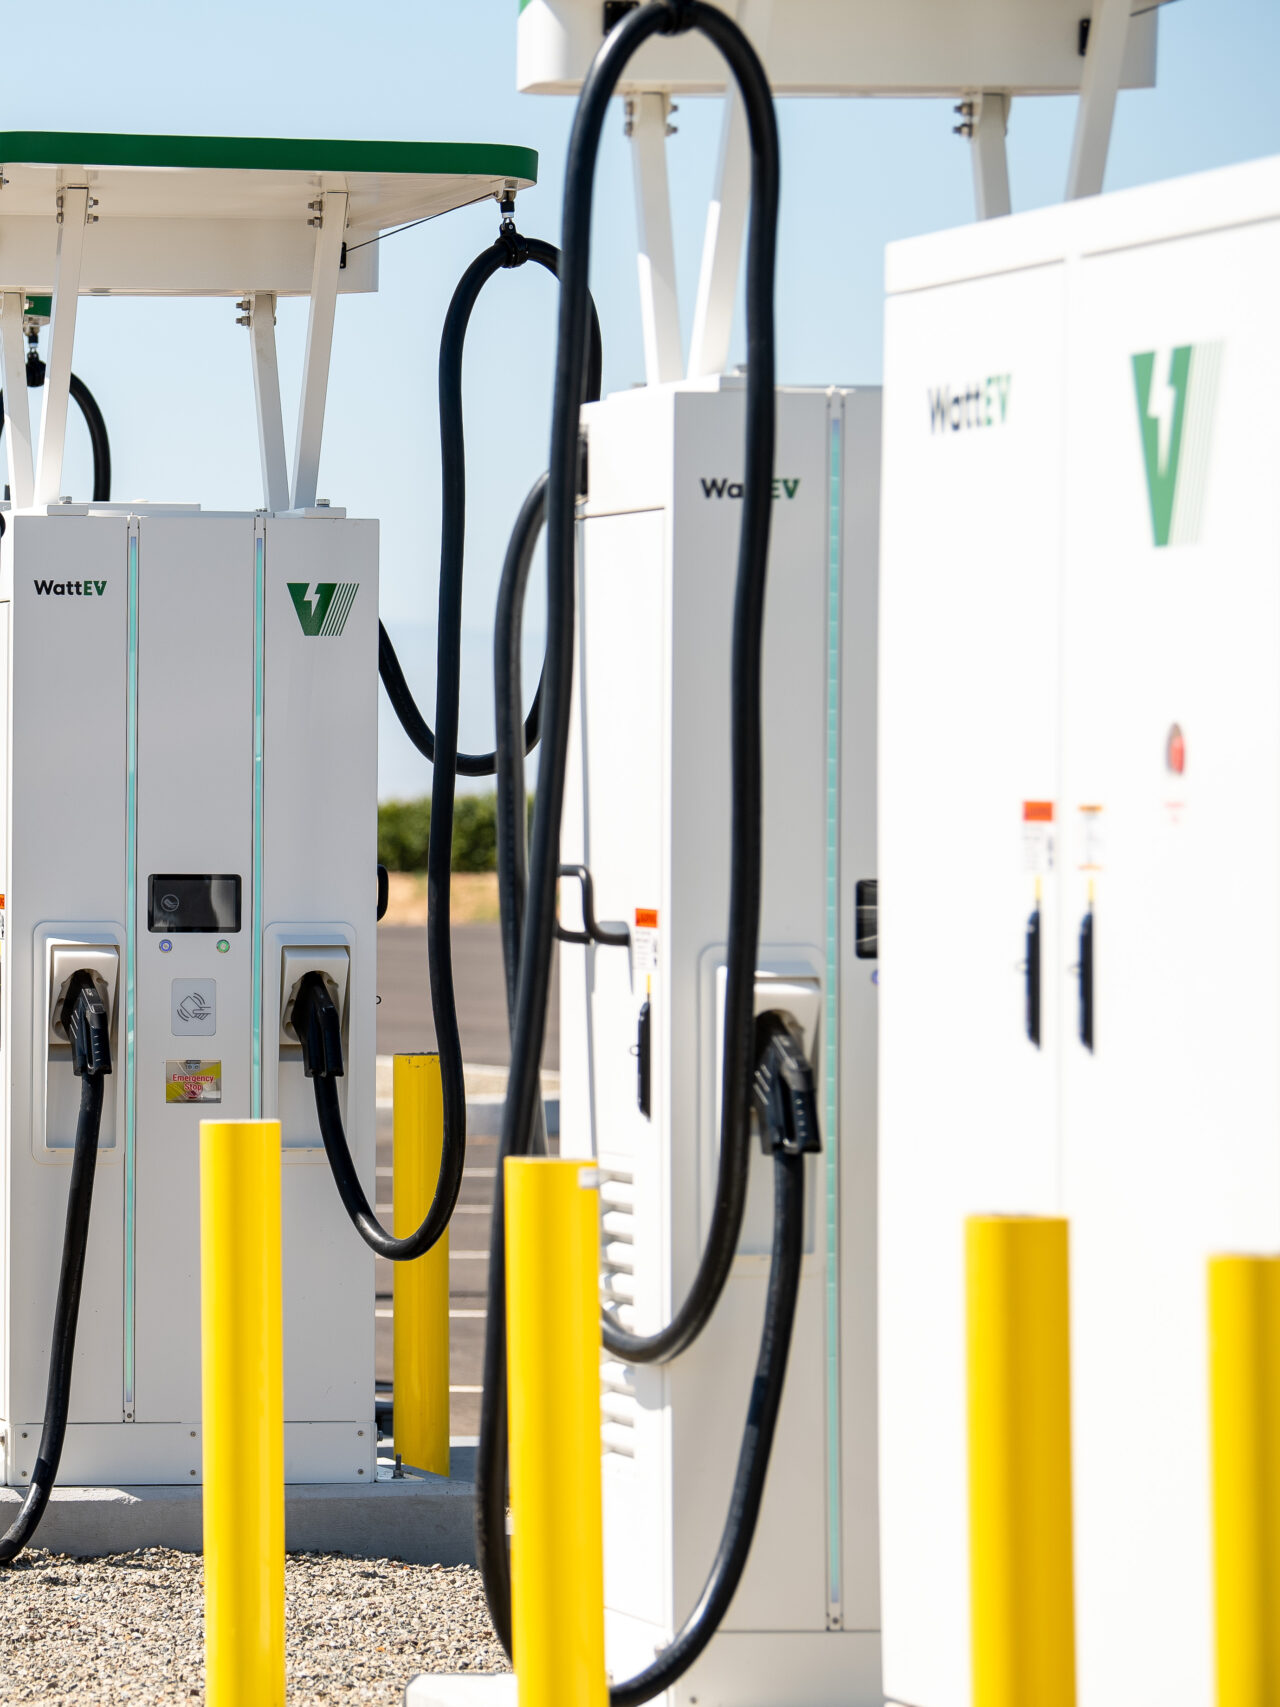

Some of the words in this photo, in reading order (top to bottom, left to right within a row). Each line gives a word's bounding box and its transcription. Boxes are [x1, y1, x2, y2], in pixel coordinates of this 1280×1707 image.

[927, 373, 1012, 433] WattEV
[699, 478, 800, 499] WaEV
[33, 579, 108, 597] WattEV
[172, 1073, 214, 1083] Emergency
[184, 1083, 202, 1091] Stop
